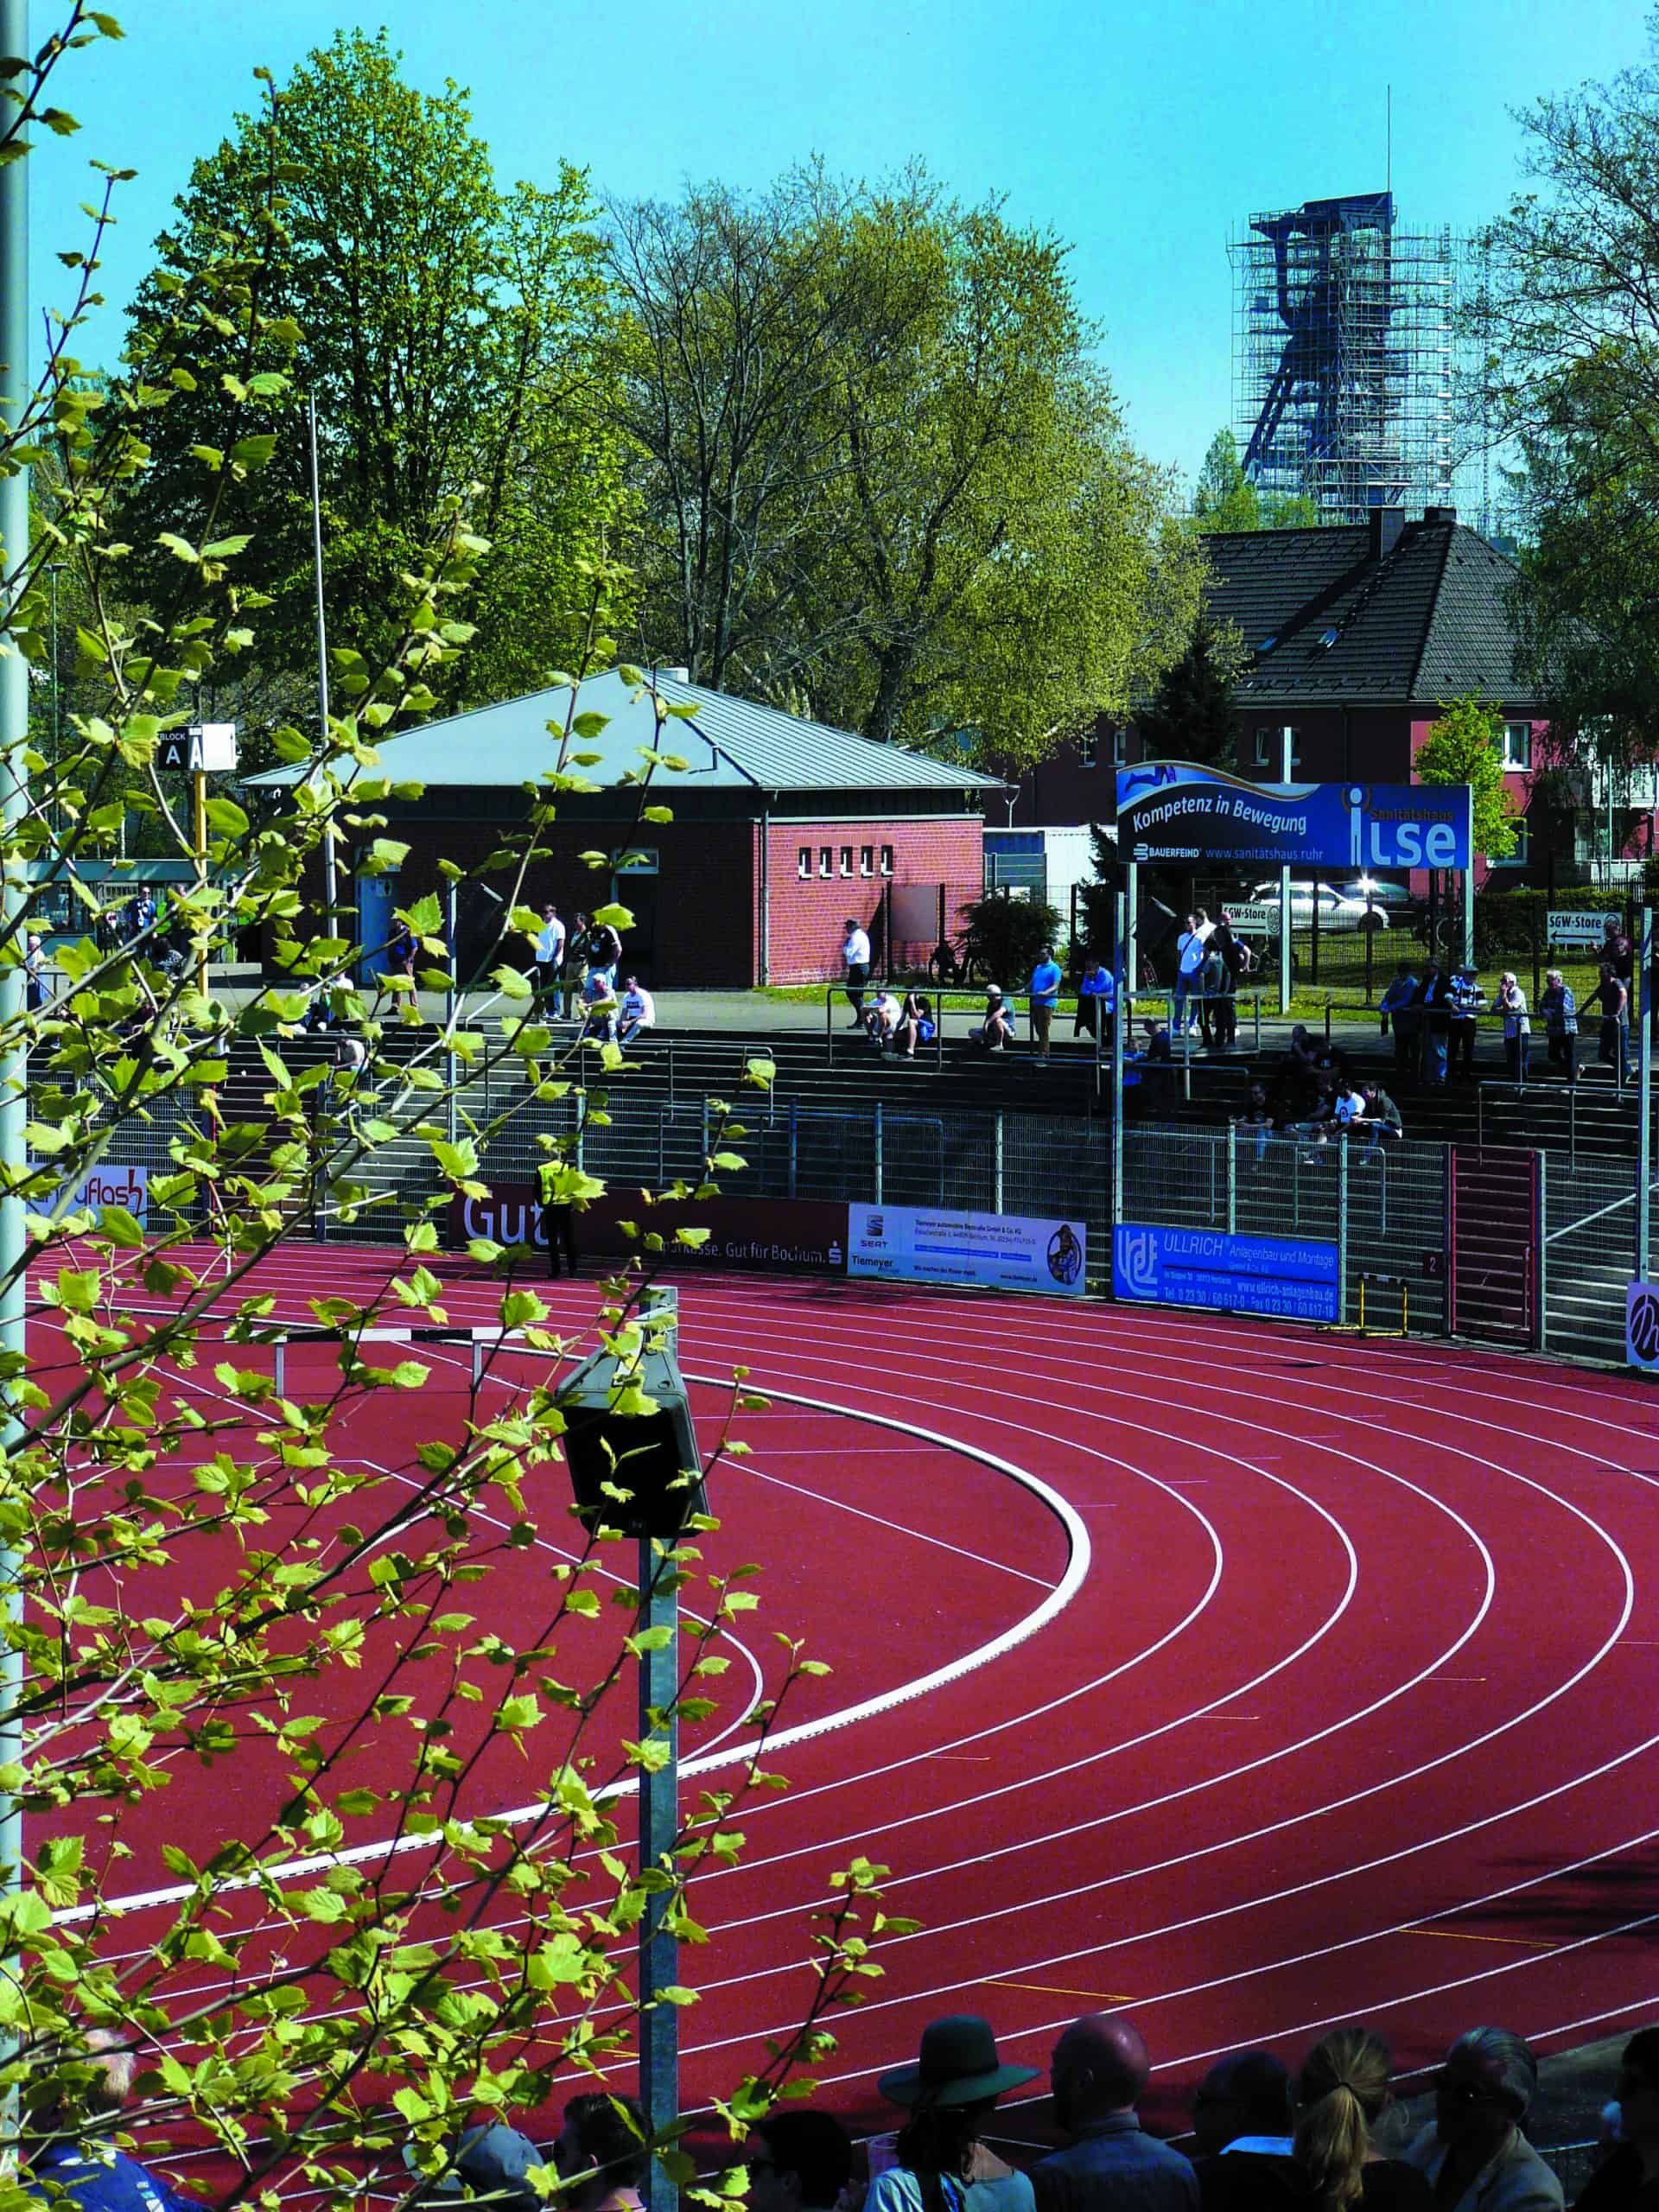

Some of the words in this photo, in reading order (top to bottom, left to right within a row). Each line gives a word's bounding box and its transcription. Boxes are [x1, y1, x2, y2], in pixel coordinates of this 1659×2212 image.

[159, 732, 186, 741] BLOCK
[166, 745, 181, 765] A
[189, 736, 203, 769] A
[1134, 797, 1212, 833] Kompetenz
[1216, 795, 1230, 814] in
[1233, 799, 1307, 836] Bewegung
[1149, 847, 1200, 858] BAUERFEIND
[1549, 915, 1602, 929] SGW-Store
[726, 1243, 747, 1259] Gut
[751, 1242, 768, 1259] für
[772, 1244, 826, 1263] Bochum.
[1164, 1232, 1224, 1257] ULLRICH
[852, 1255, 893, 1272] Tiemeyer
[1230, 1244, 1278, 1261] Anlagenbau
[1280, 1250, 1296, 1263] und
[1298, 1250, 1334, 1270] Montage
[1429, 1256, 1436, 1272] 2
